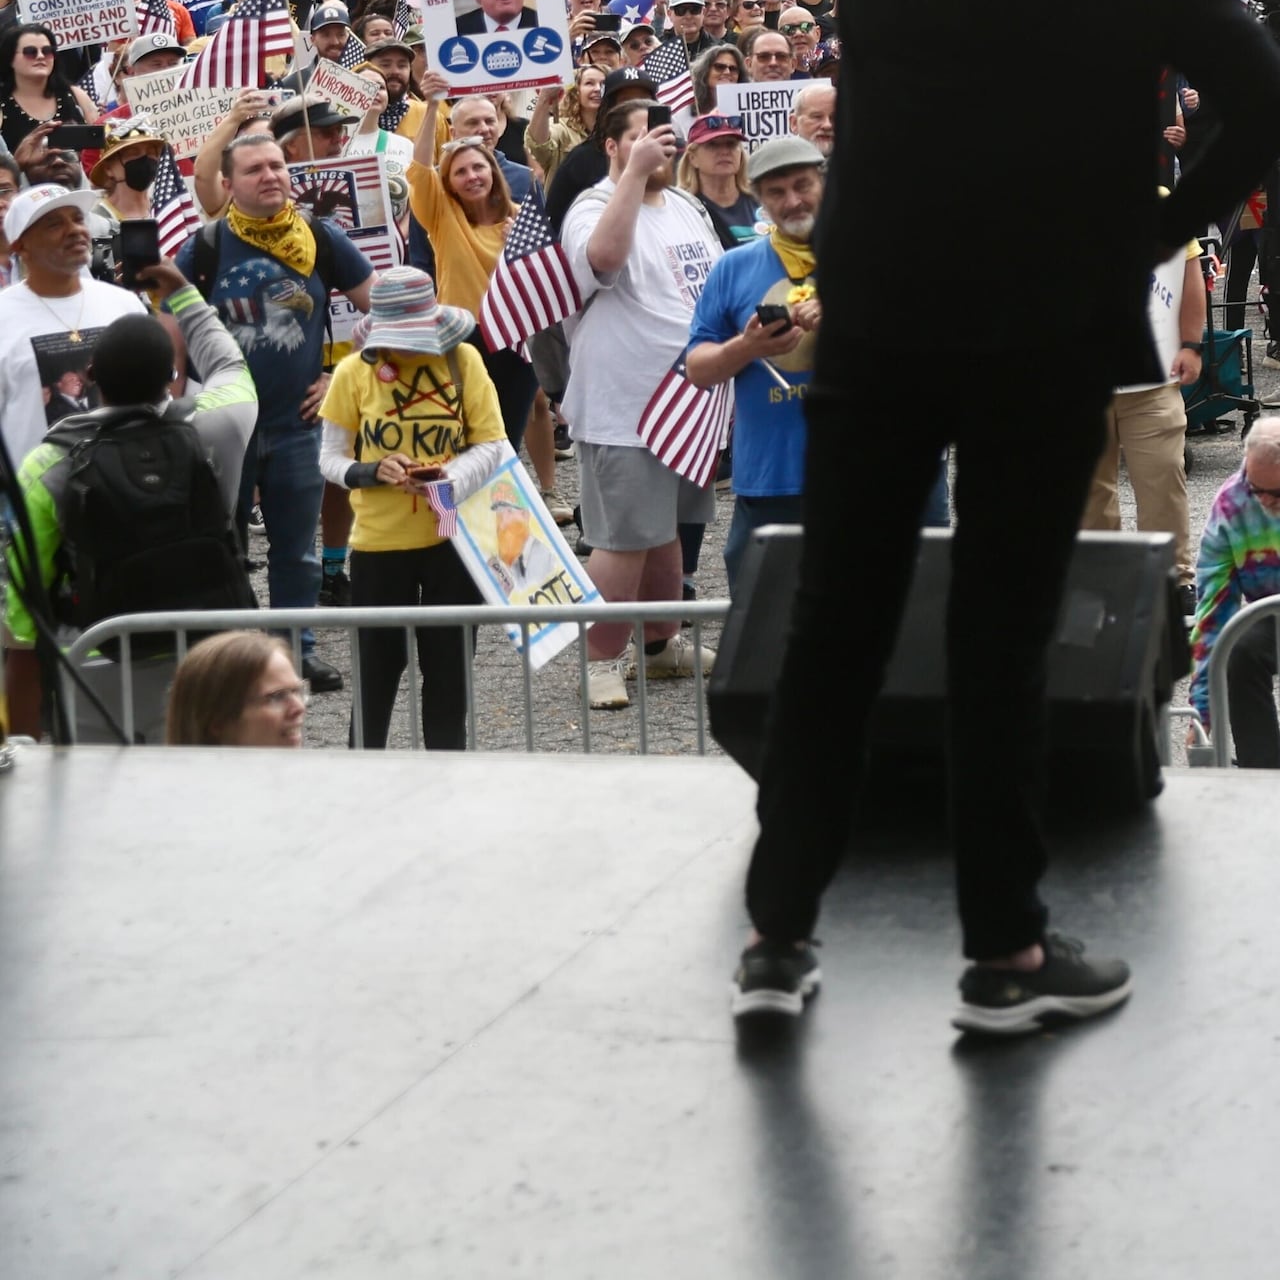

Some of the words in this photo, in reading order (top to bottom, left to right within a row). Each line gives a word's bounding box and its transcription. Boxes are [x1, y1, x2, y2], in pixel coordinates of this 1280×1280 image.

[32, 11, 61, 21] AGAINST
[63, 7, 74, 15] ALL
[77, 1, 105, 12] ENEMIES
[106, 0, 125, 7] BOTH
[41, 12, 93, 32] OREIGN
[99, 6, 127, 22] AND
[56, 20, 130, 47] OMESTIC
[135, 76, 175, 100] WHEN
[312, 68, 372, 110] NUREMBERG
[738, 89, 794, 111] LIBERTY
[179, 122, 213, 137] WERE
[305, 169, 346, 183] KINGS
[361, 418, 402, 453] NO
